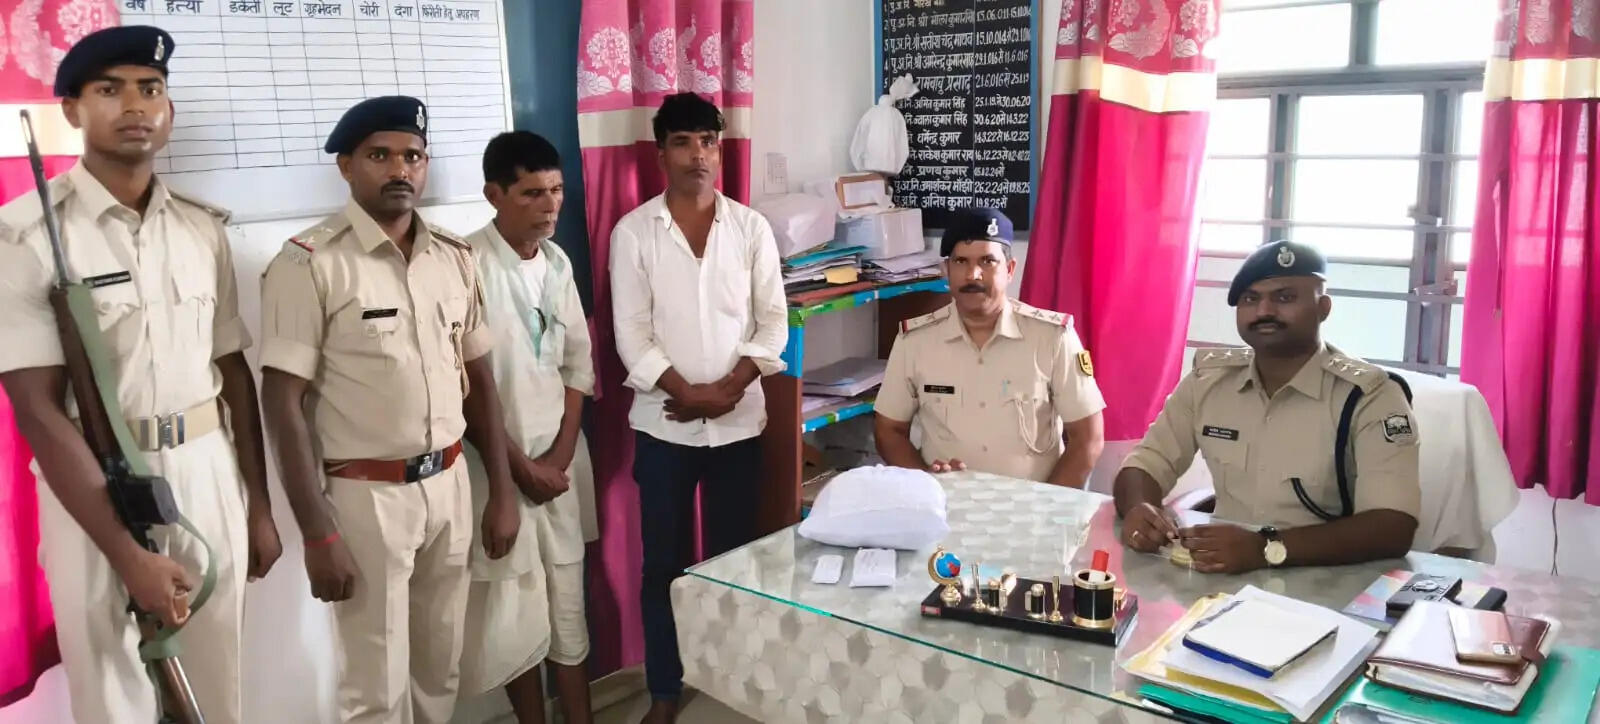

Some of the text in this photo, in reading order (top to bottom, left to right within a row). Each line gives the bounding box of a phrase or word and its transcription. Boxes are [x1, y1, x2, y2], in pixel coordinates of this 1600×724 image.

[273, 2, 294, 16] लूट
[359, 2, 381, 17] चोरी
[394, 4, 414, 17] दंगा
[938, 131, 963, 147] कुमार
[940, 149, 961, 164] कुमार
[946, 196, 973, 211] कुमार
